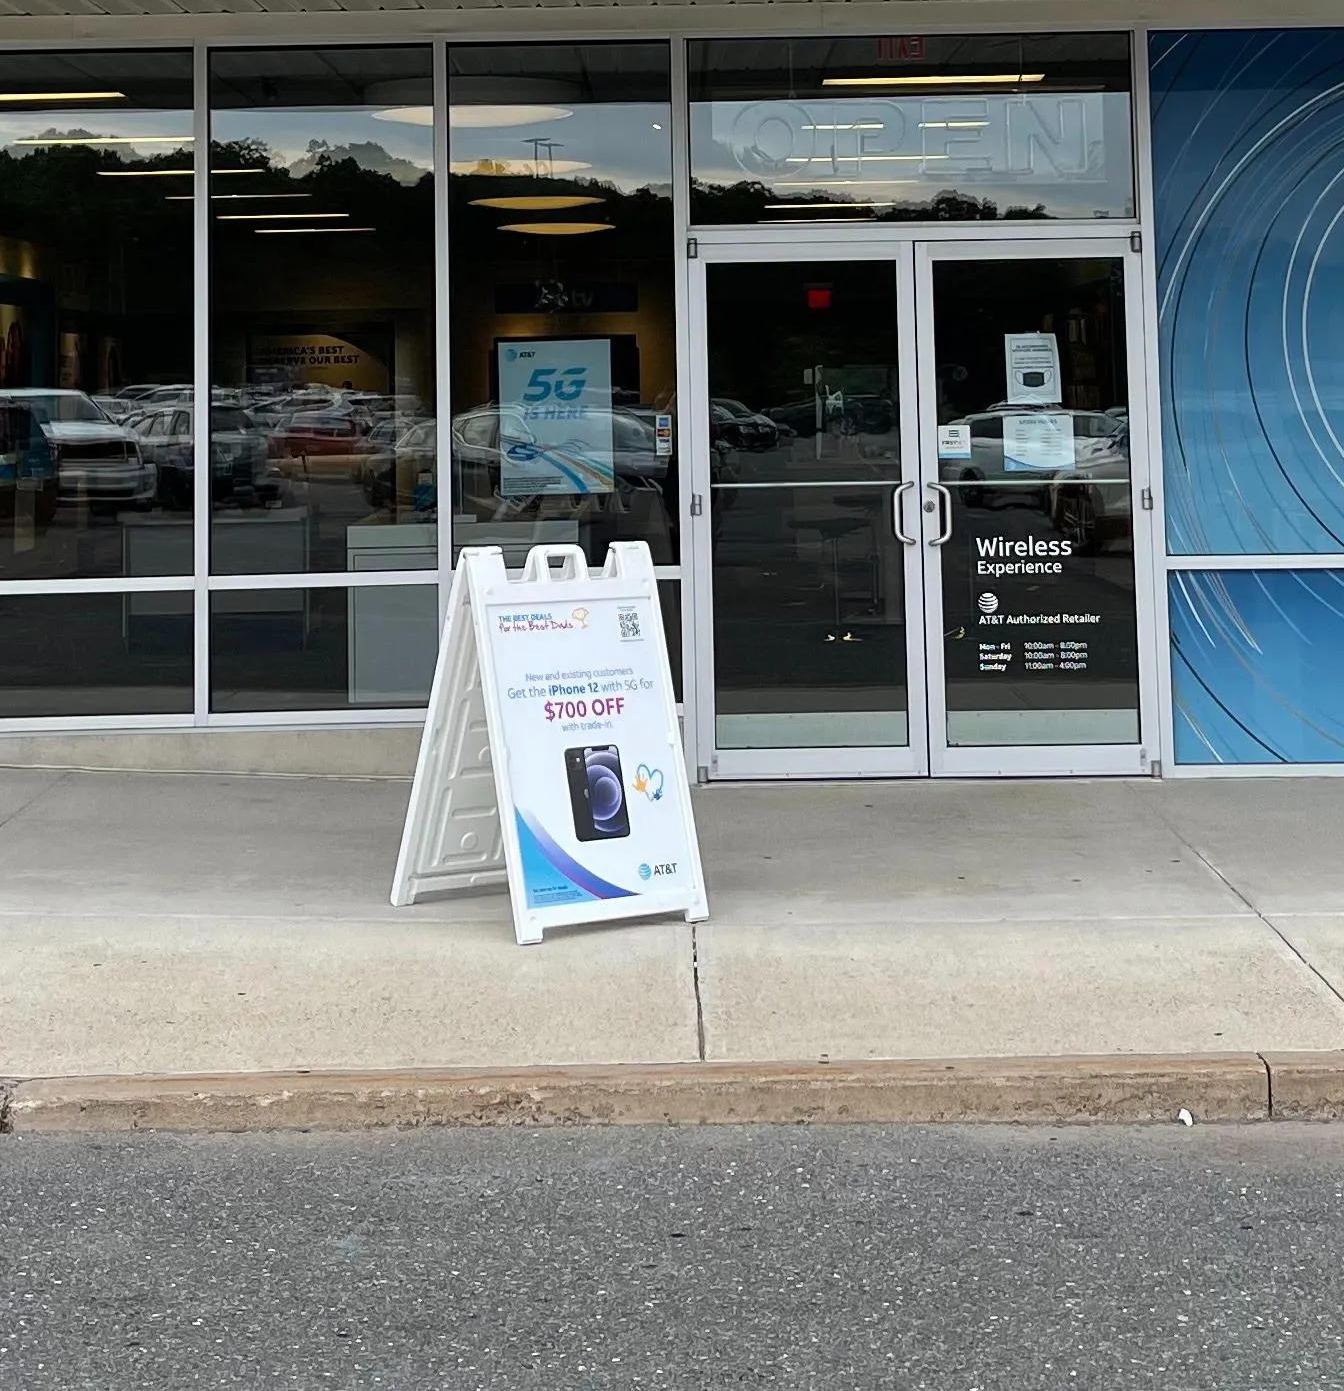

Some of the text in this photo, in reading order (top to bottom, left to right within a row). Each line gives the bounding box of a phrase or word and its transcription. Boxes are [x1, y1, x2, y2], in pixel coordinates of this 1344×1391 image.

[731, 98, 1088, 179] OPEN
[318, 345, 344, 354] BEST
[519, 351, 535, 359] AT&T
[309, 355, 330, 365] OUR
[334, 355, 360, 364] BEST
[523, 367, 587, 401] 5G
[524, 405, 589, 421] IS HERE
[976, 535, 1072, 557] Wireless
[977, 560, 1062, 577] Experience
[513, 613, 530, 622] BEST
[531, 613, 552, 621] DEALS
[979, 613, 1101, 625] AT&T Authorized Retailer
[513, 621, 527, 632] the
[528, 620, 549, 631] Best
[551, 619, 574, 630] Dads
[1001, 642, 1011, 650] Fri
[979, 652, 1012, 661] Saturday
[979, 663, 1006, 671] Sunday
[526, 667, 633, 682] New and existing customers
[508, 678, 654, 699] Get the iPhone 12 with 5G for
[544, 697, 624, 722] $700 OFF
[561, 722, 579, 731] with
[653, 863, 677, 876] AT&T
